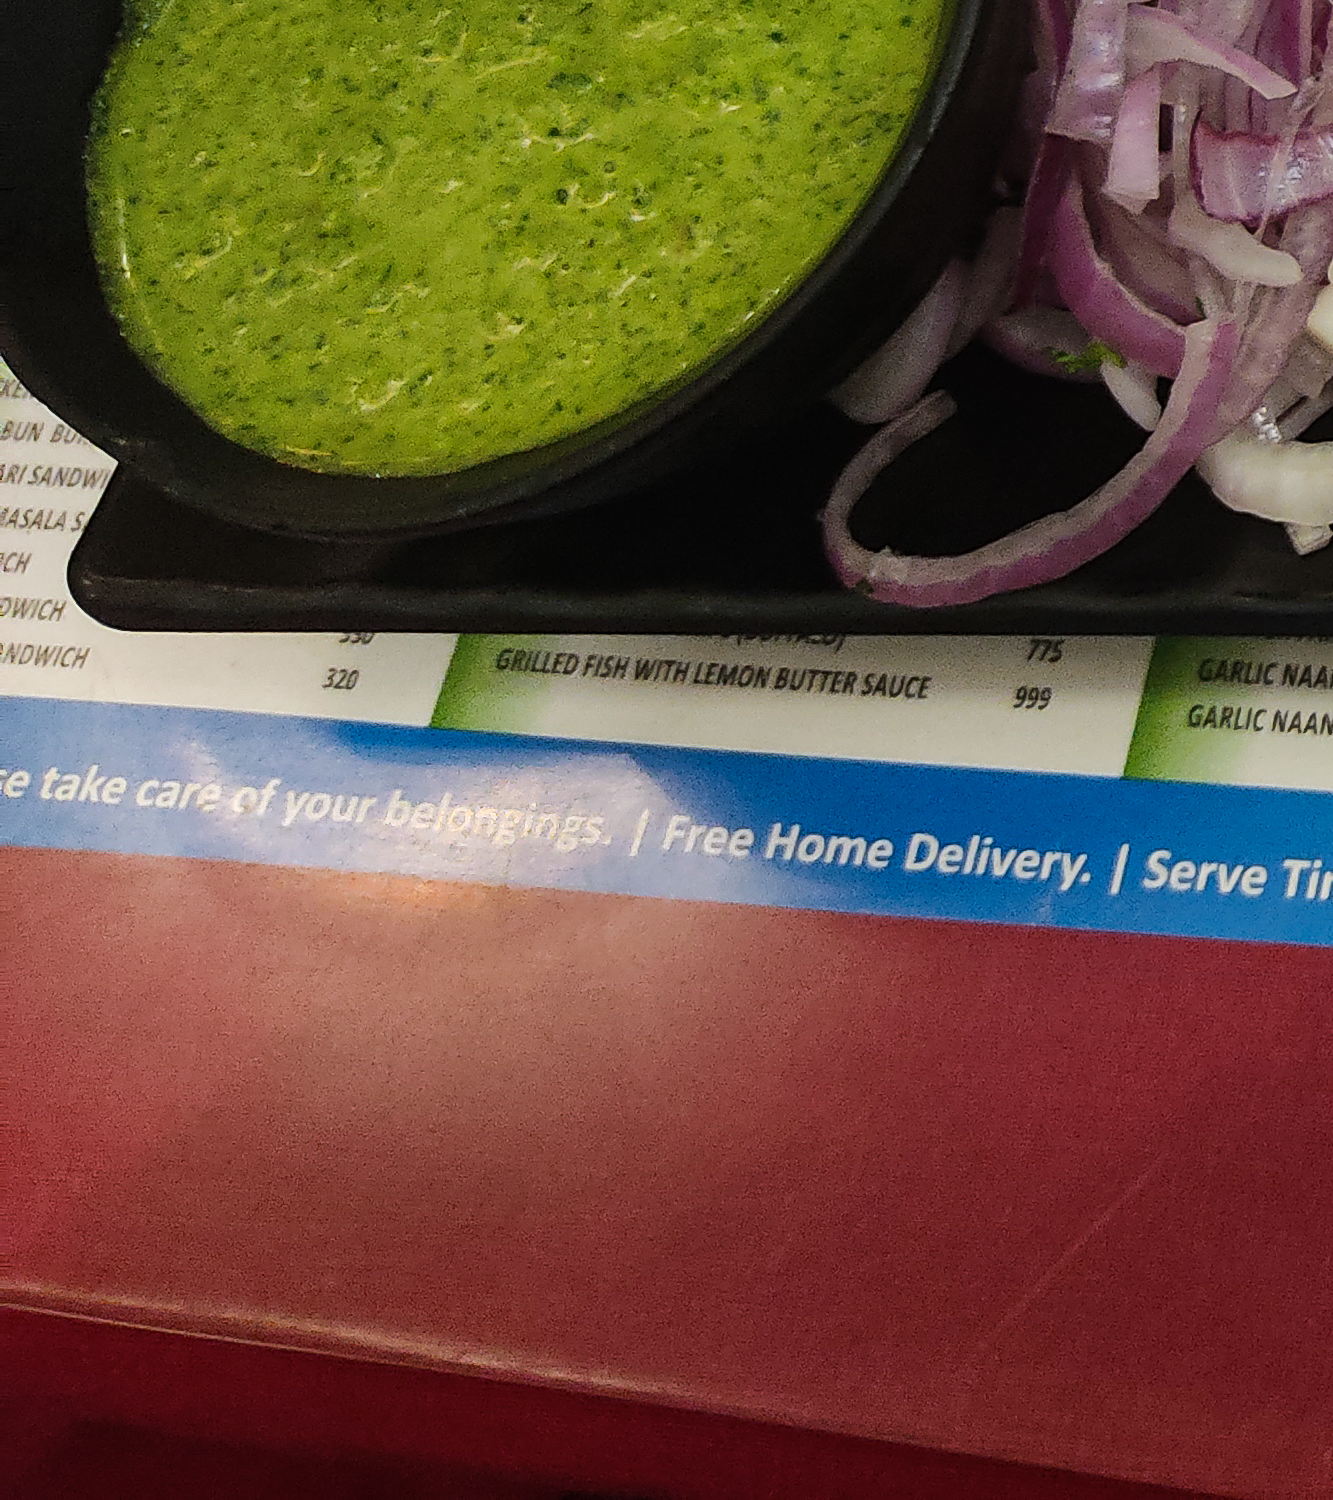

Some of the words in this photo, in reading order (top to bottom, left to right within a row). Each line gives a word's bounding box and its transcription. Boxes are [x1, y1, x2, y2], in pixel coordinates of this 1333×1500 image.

[1028, 639, 1063, 663] 775
[323, 668, 359, 690] 320
[496, 648, 581, 677] GRILLED
[582, 652, 630, 680] FISH
[636, 657, 690, 681] WITH
[694, 662, 772, 688] LEMON
[774, 666, 857, 694] BUTTER
[861, 673, 932, 699] SAUCE
[1200, 658, 1275, 686] GARLIC
[1012, 685, 1052, 711] 999
[1188, 704, 1269, 732] GARLIC
[41, 765, 128, 806] take
[135, 778, 226, 812] care
[232, 779, 281, 816] of
[283, 792, 375, 828] your
[384, 790, 611, 852] belongings.
[664, 812, 751, 859] Free
[764, 822, 894, 869] Home
[905, 834, 1091, 892] Delivery.
[1144, 849, 1266, 898] Serve
